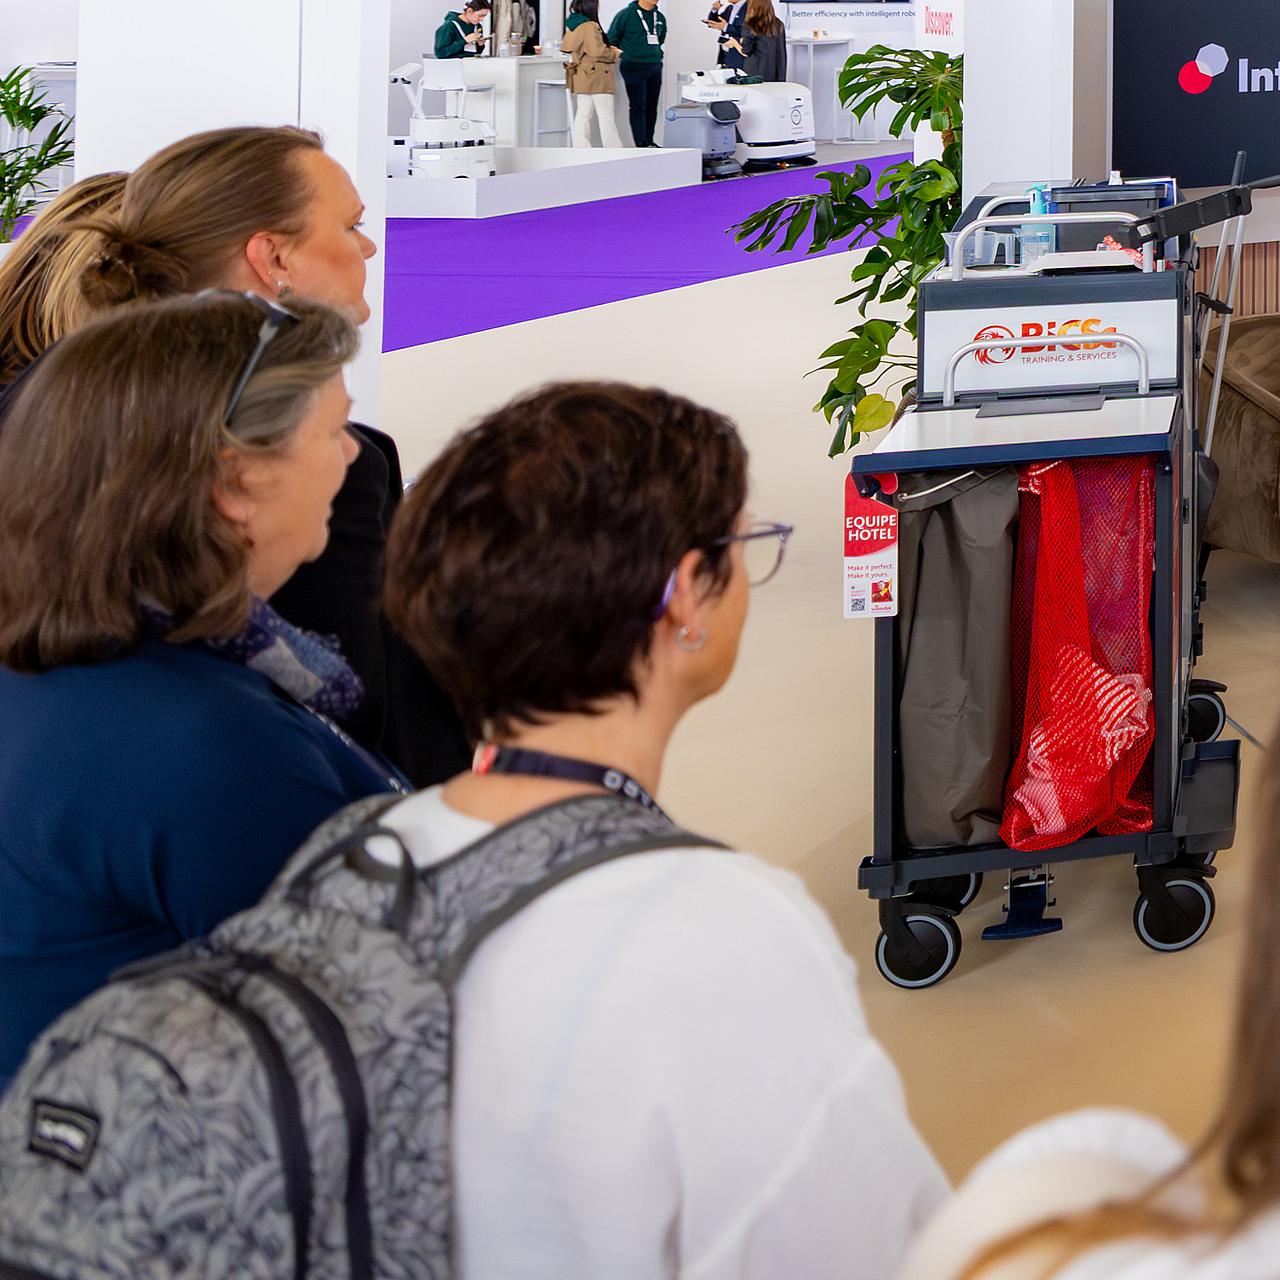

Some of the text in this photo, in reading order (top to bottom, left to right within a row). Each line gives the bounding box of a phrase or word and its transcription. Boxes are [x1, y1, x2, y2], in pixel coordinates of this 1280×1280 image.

[792, 10, 813, 18] Better
[814, 10, 847, 19] efficiency
[849, 10, 864, 18] with
[865, 10, 901, 19] intelligent
[1021, 351, 1117, 365] TRAINING & SERVICES
[845, 514, 897, 530] EQUIPE
[848, 528, 895, 542] HOTEL
